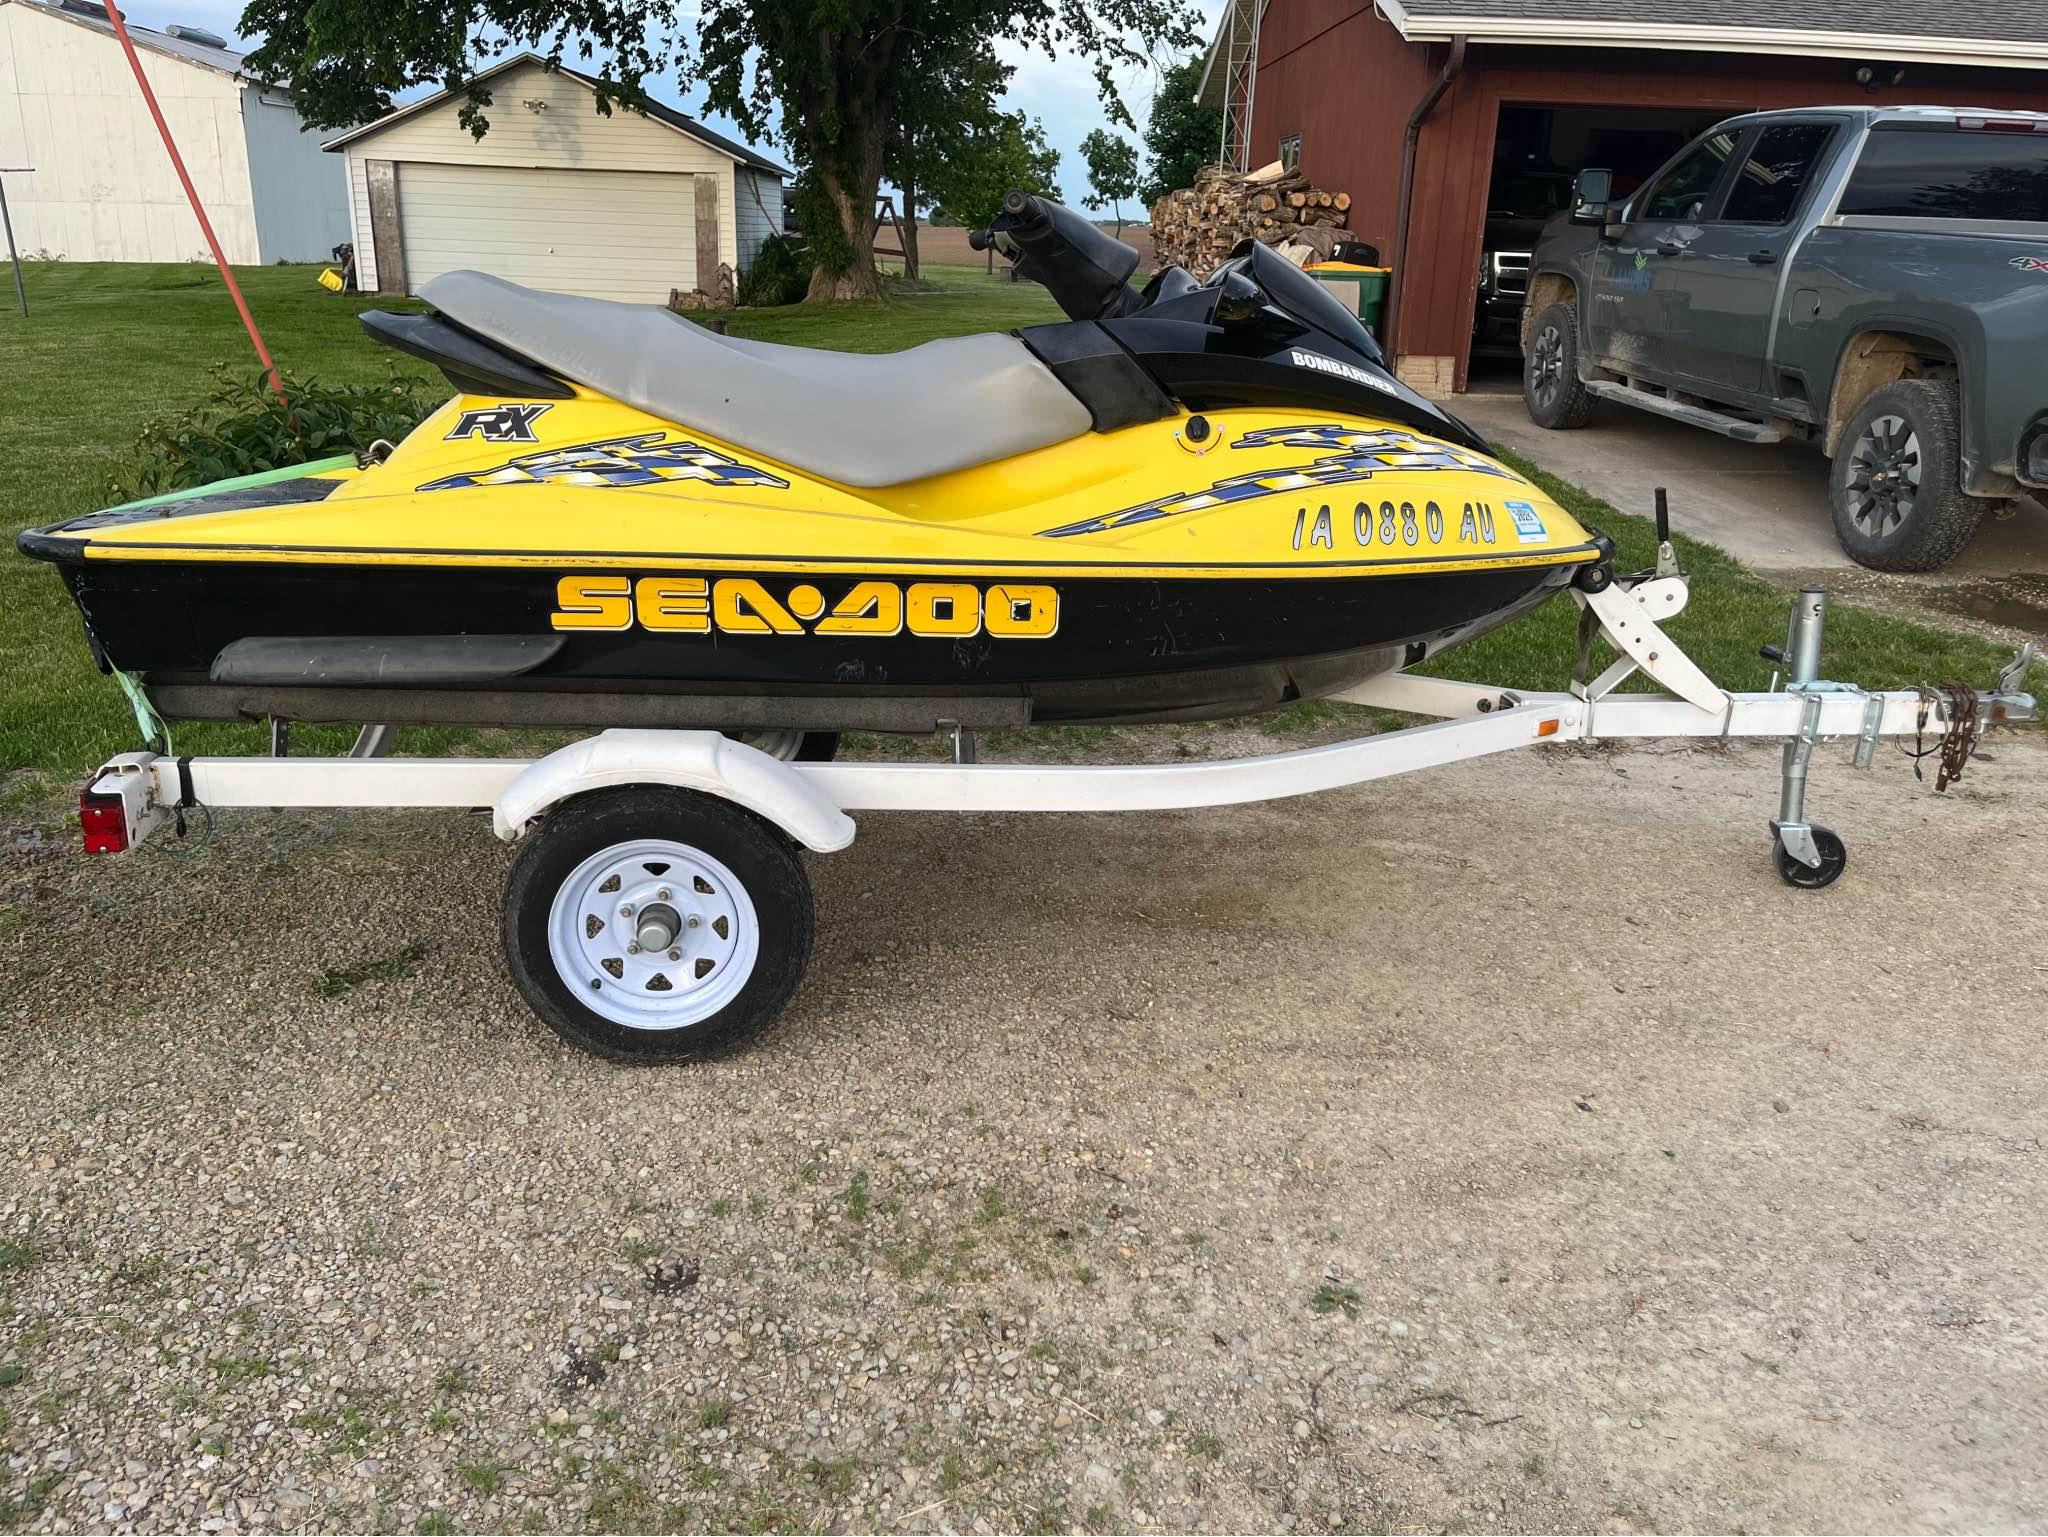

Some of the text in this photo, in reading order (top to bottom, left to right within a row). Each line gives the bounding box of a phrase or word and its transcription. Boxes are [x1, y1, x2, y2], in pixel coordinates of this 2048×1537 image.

[1291, 351, 1398, 396] BOMBARDIER
[443, 404, 555, 442] RX
[1292, 501, 1496, 550] IA 0880 AU
